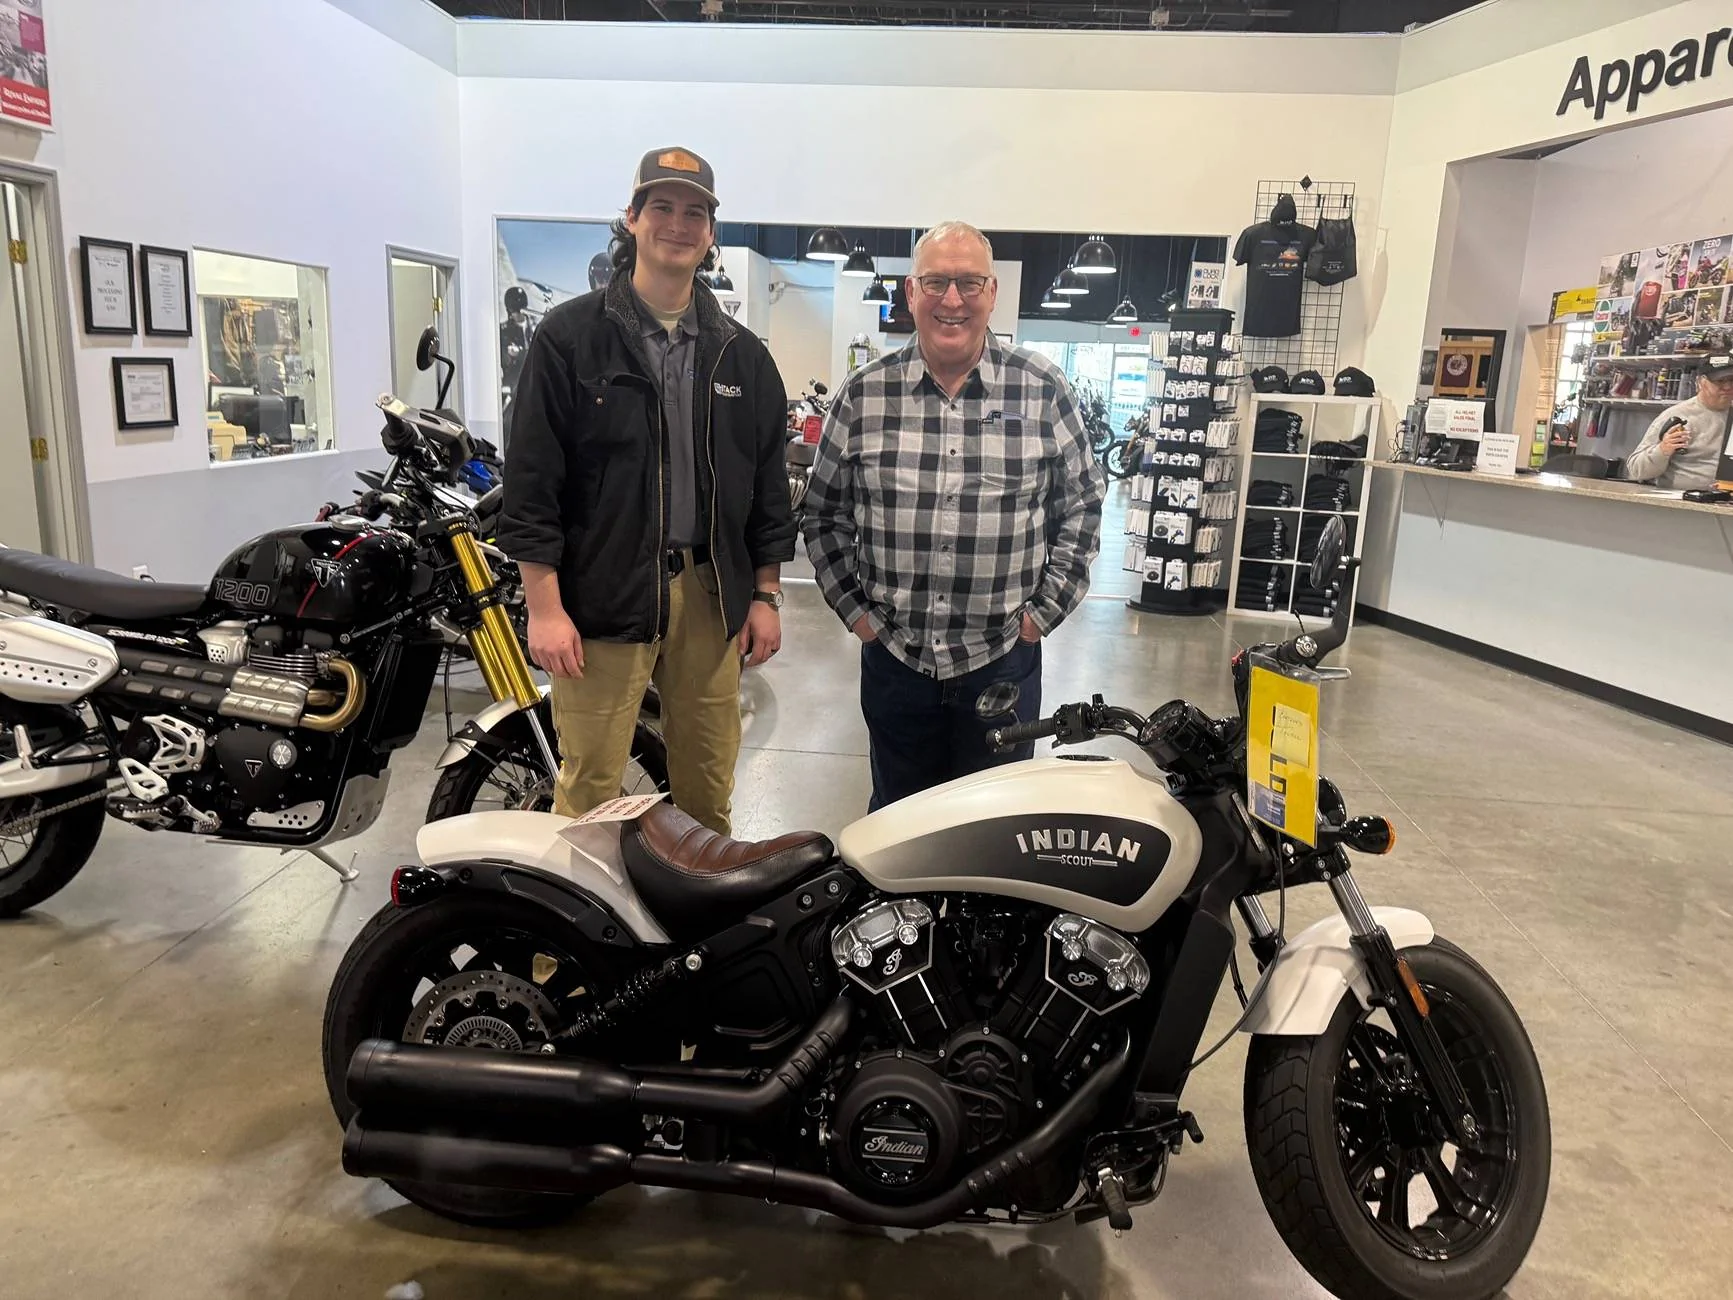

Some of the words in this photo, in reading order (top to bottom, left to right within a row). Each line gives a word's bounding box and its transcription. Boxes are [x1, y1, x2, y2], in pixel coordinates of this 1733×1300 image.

[1556, 27, 1733, 120] Appar
[214, 577, 271, 606] 1200
[1015, 828, 1142, 863] INDIAN
[1060, 854, 1094, 867] SCOUT
[864, 1135, 924, 1155] Indian
